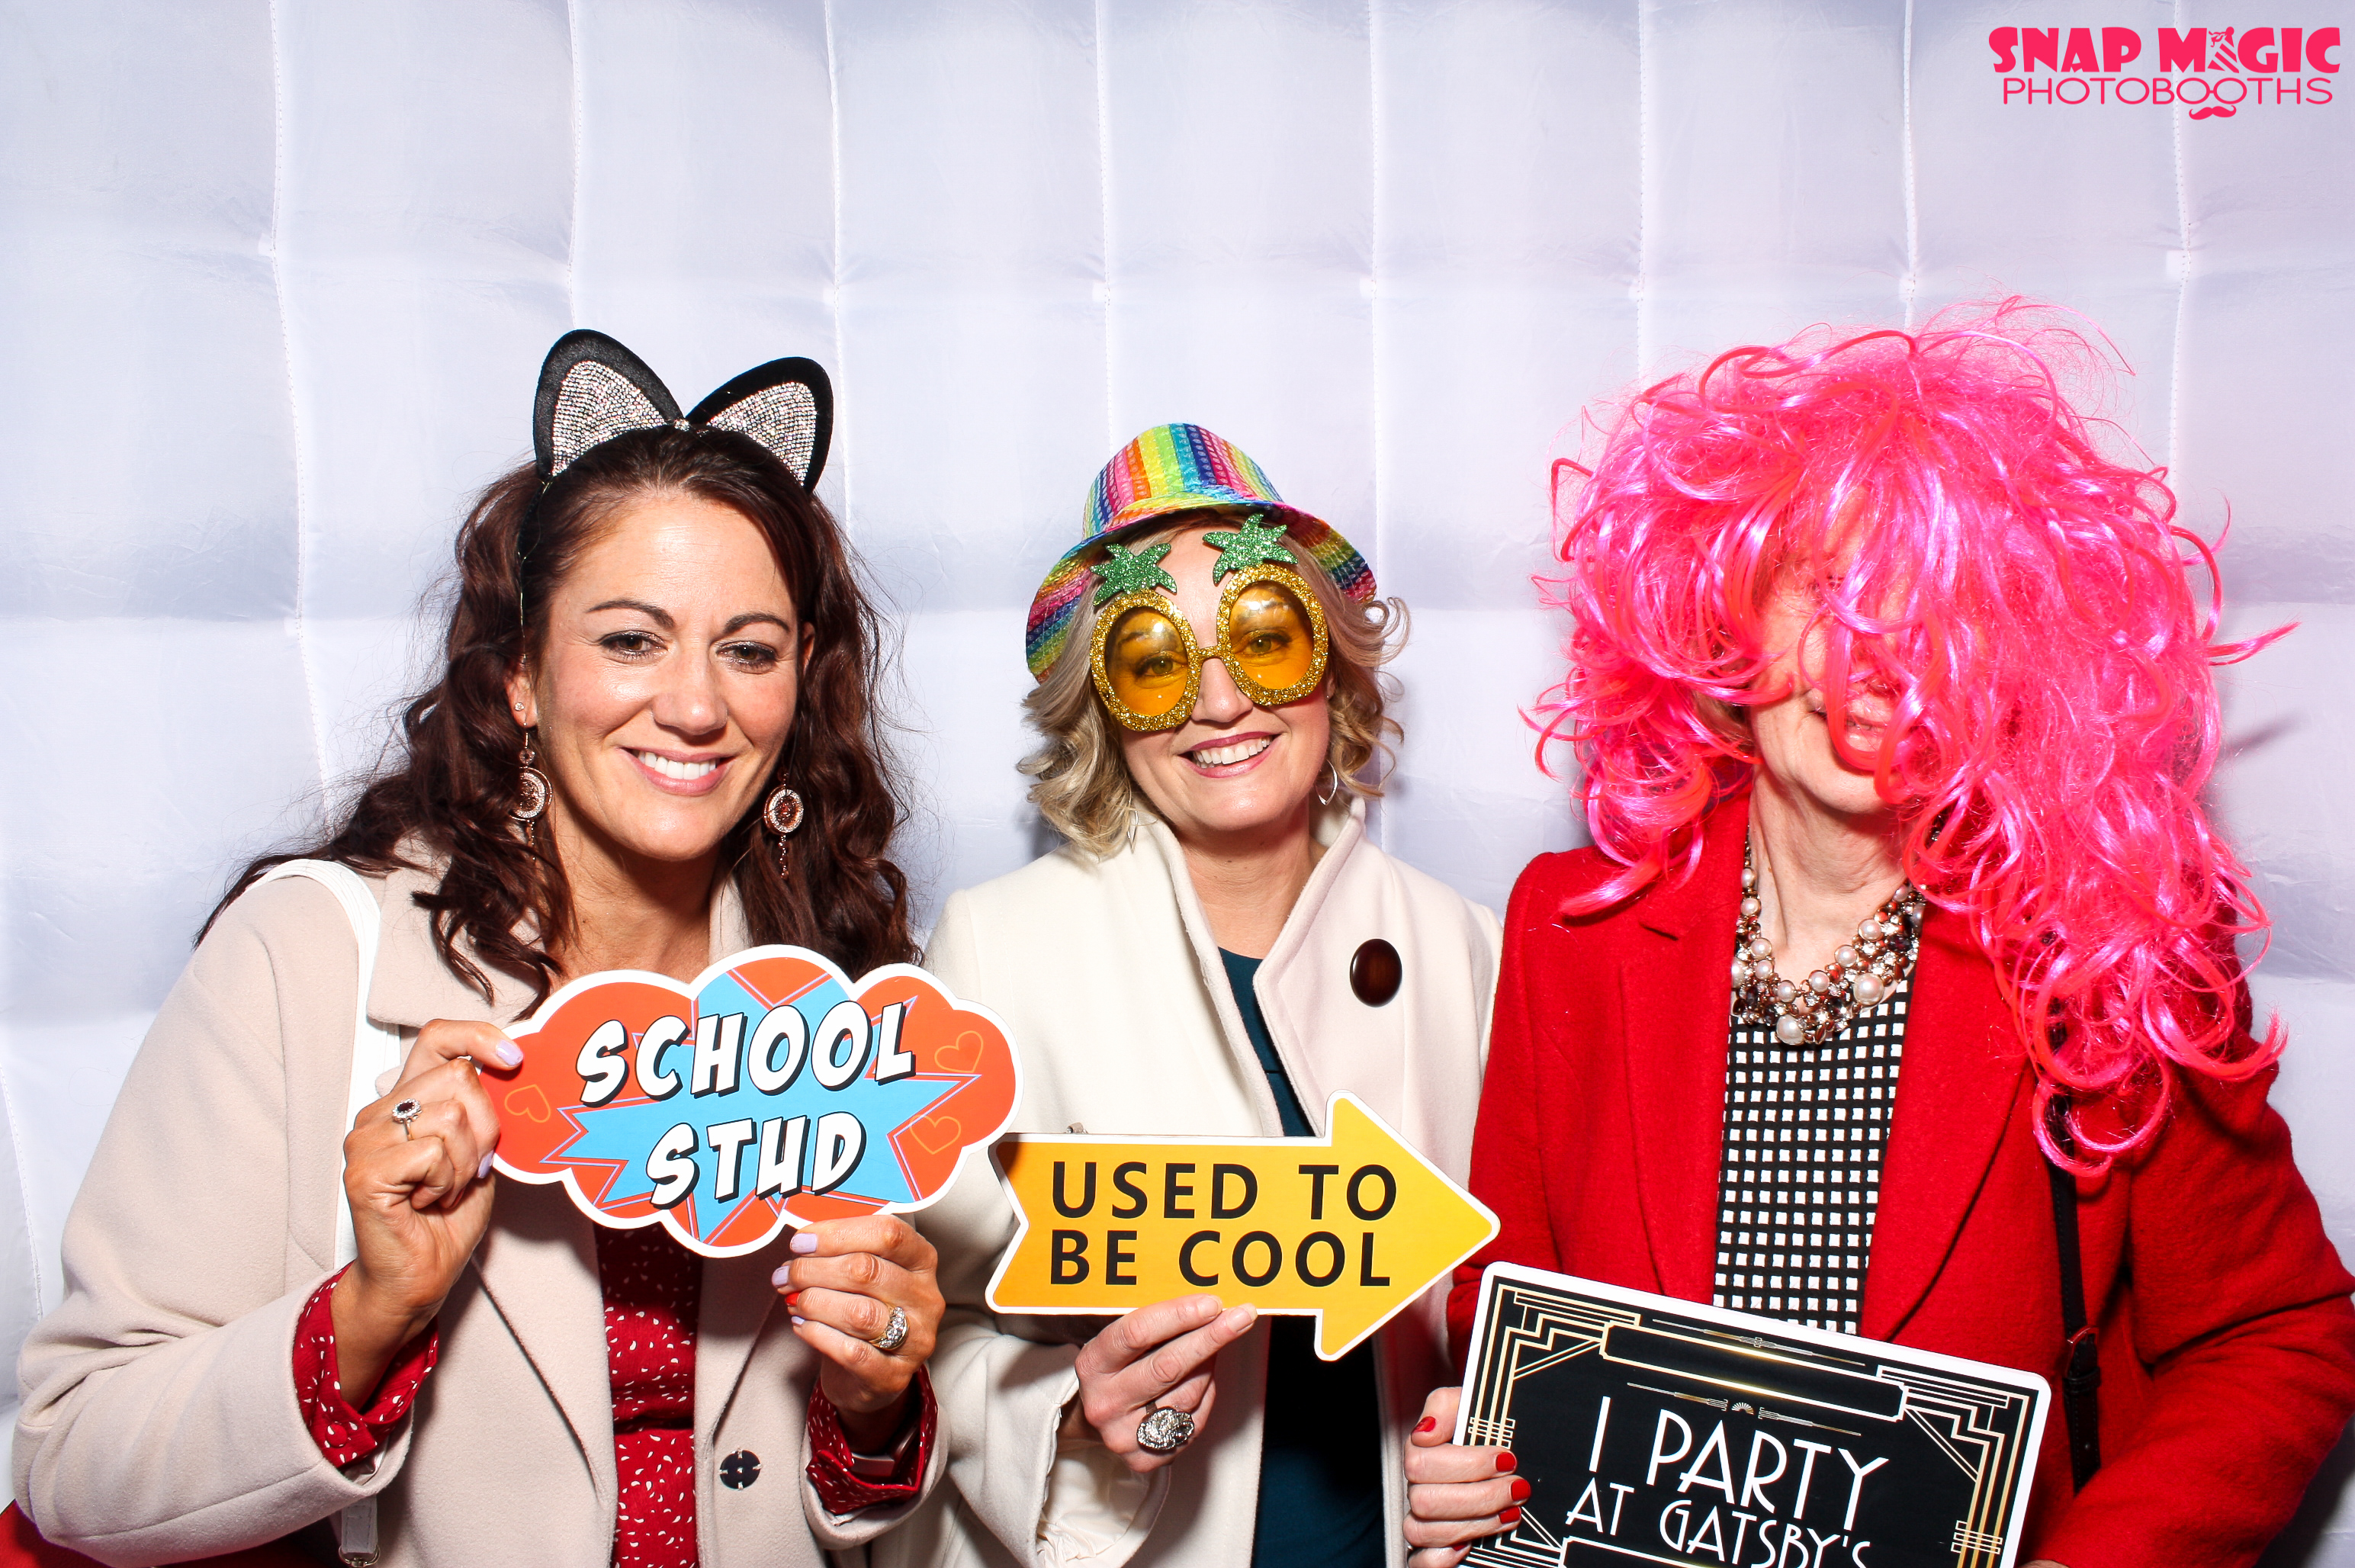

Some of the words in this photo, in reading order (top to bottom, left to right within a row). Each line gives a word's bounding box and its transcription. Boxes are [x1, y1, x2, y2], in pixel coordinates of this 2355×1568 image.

[575, 1001, 915, 1105] SCHOOL
[646, 1111, 866, 1210] STUD
[1052, 1161, 1258, 1219] USED
[1298, 1164, 1397, 1221] TO
[1050, 1229, 1138, 1286] BE
[1178, 1230, 1390, 1287] COOL
[1589, 1396, 1611, 1473] I
[1646, 1409, 1889, 1531] PARTY
[1566, 1476, 1635, 1537] AT
